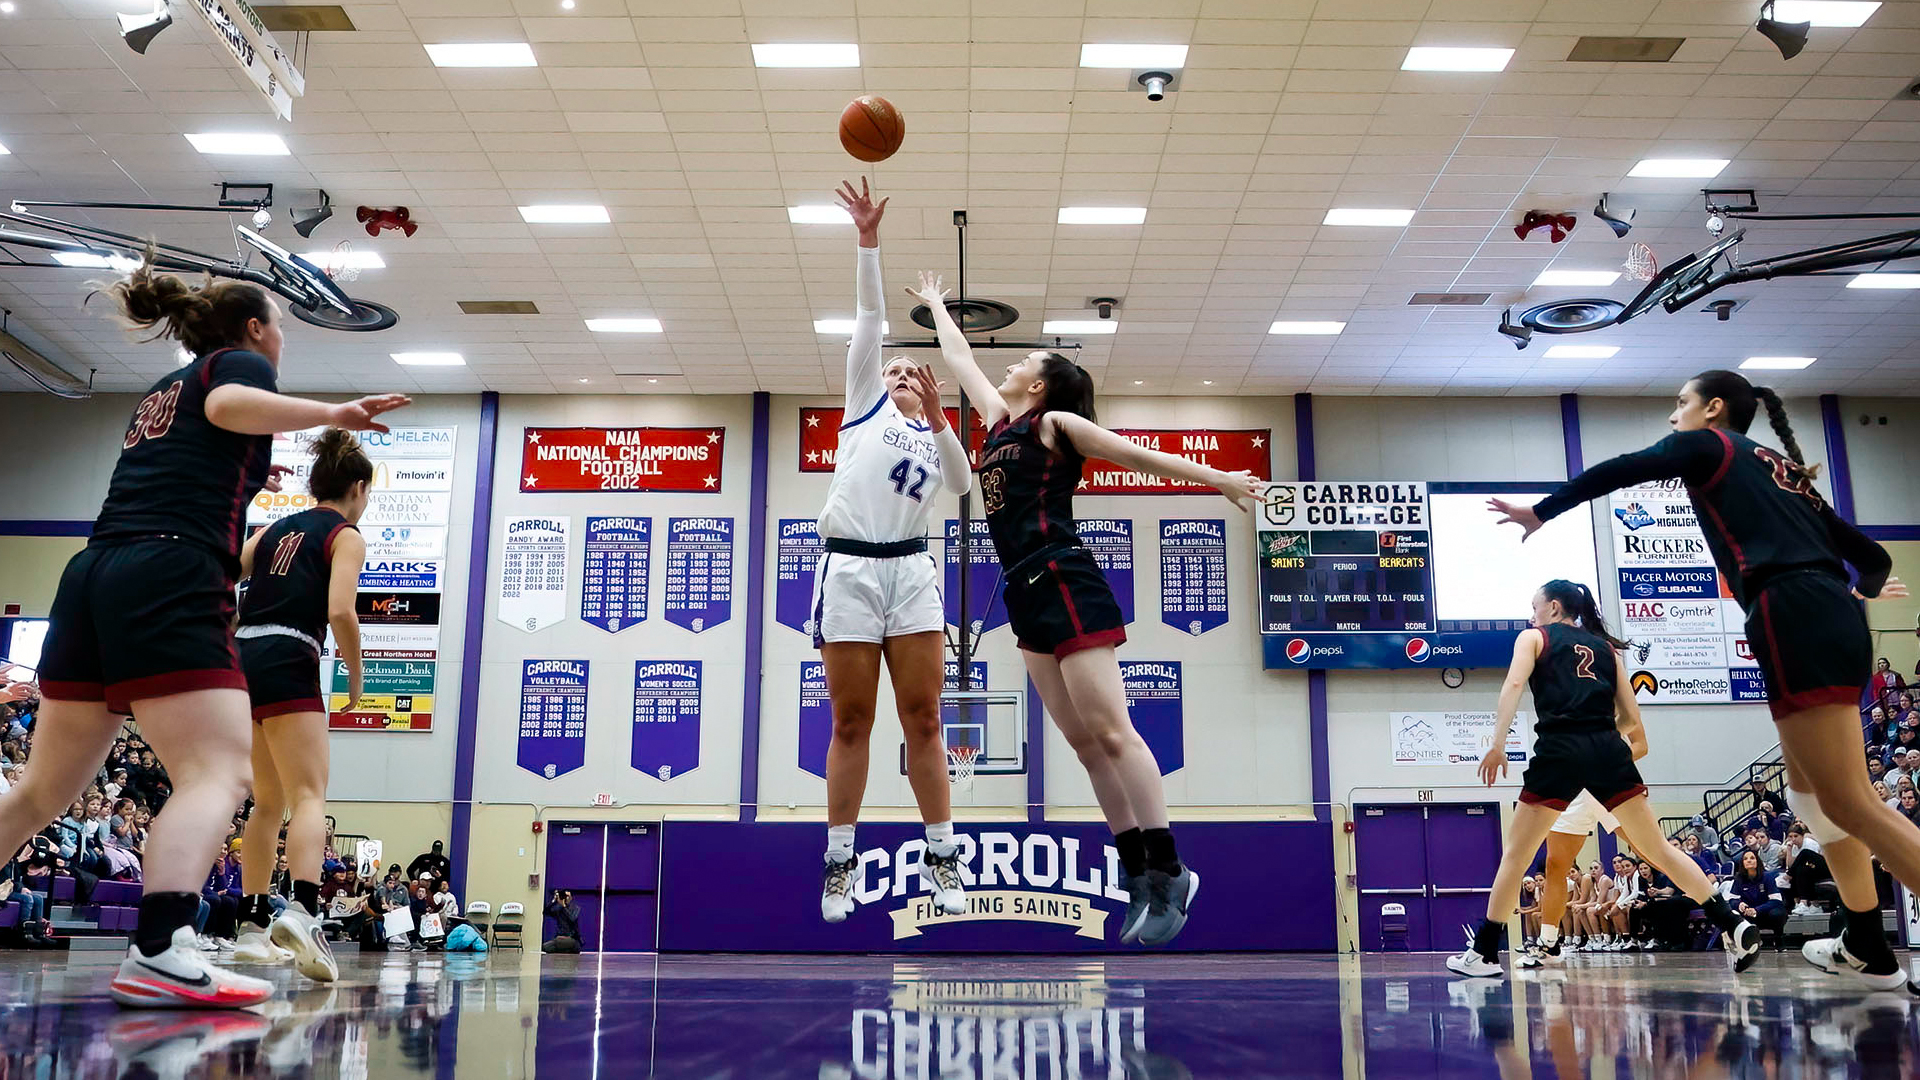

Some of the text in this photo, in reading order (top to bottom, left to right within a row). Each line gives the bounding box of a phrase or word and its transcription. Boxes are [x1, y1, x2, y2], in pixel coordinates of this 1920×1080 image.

[124, 381, 183, 449] 30
[396, 431, 450, 443] HELENA
[605, 430, 641, 445] NAIA
[1182, 435, 1219, 450] NAIA
[537, 446, 709, 460] NATIONAL CHAMPIONS
[580, 461, 662, 475] FOOTBALL
[601, 475, 639, 489] 2002
[888, 457, 930, 503] 42
[1093, 471, 1165, 486] NATIONAL
[367, 495, 432, 503] MONTANA
[1303, 485, 1423, 503] CARROLL
[366, 512, 430, 521] COMPANY
[1657, 518, 1699, 527] HIGHLIGH
[509, 519, 564, 534] CARROLL
[590, 518, 647, 533] CARROLL
[673, 519, 729, 533] CARROLL
[1164, 522, 1220, 537] CARROLL
[597, 533, 640, 541] FOOTBALL
[679, 533, 722, 541] FOOTBALL
[1623, 535, 1704, 553] RUCKERS
[270, 532, 305, 575] 11
[363, 562, 437, 572] LARK'S
[1271, 557, 1305, 568] SAINTS
[1333, 563, 1358, 571] PERIOD
[1379, 557, 1425, 568] BEARCATS
[1622, 572, 1713, 582] PLACER MOTORS
[1403, 594, 1425, 602] FOULS
[1625, 603, 1665, 618] HAC
[1670, 605, 1715, 619] Gymtrix
[1269, 623, 1291, 631] SCORE
[1336, 622, 1360, 630] MATCH
[1405, 622, 1427, 630] SCORE
[360, 633, 396, 643] PREMIER
[1313, 646, 1344, 657] pepsi
[1433, 645, 1463, 656] pepsi
[527, 660, 585, 676] CARROLL
[1573, 644, 1598, 681] 2
[405, 663, 431, 675] Bank
[640, 663, 697, 679] CARROLL
[1120, 664, 1177, 679] CARROLL
[1731, 671, 1756, 680] HELENA
[1660, 679, 1728, 689] OrthoRehab
[397, 700, 411, 708] CAT
[598, 794, 610, 804] EXIT
[1418, 790, 1434, 801] EXIT
[854, 832, 1130, 904] CARROLL
[1013, 896, 1082, 920] SAINTS
